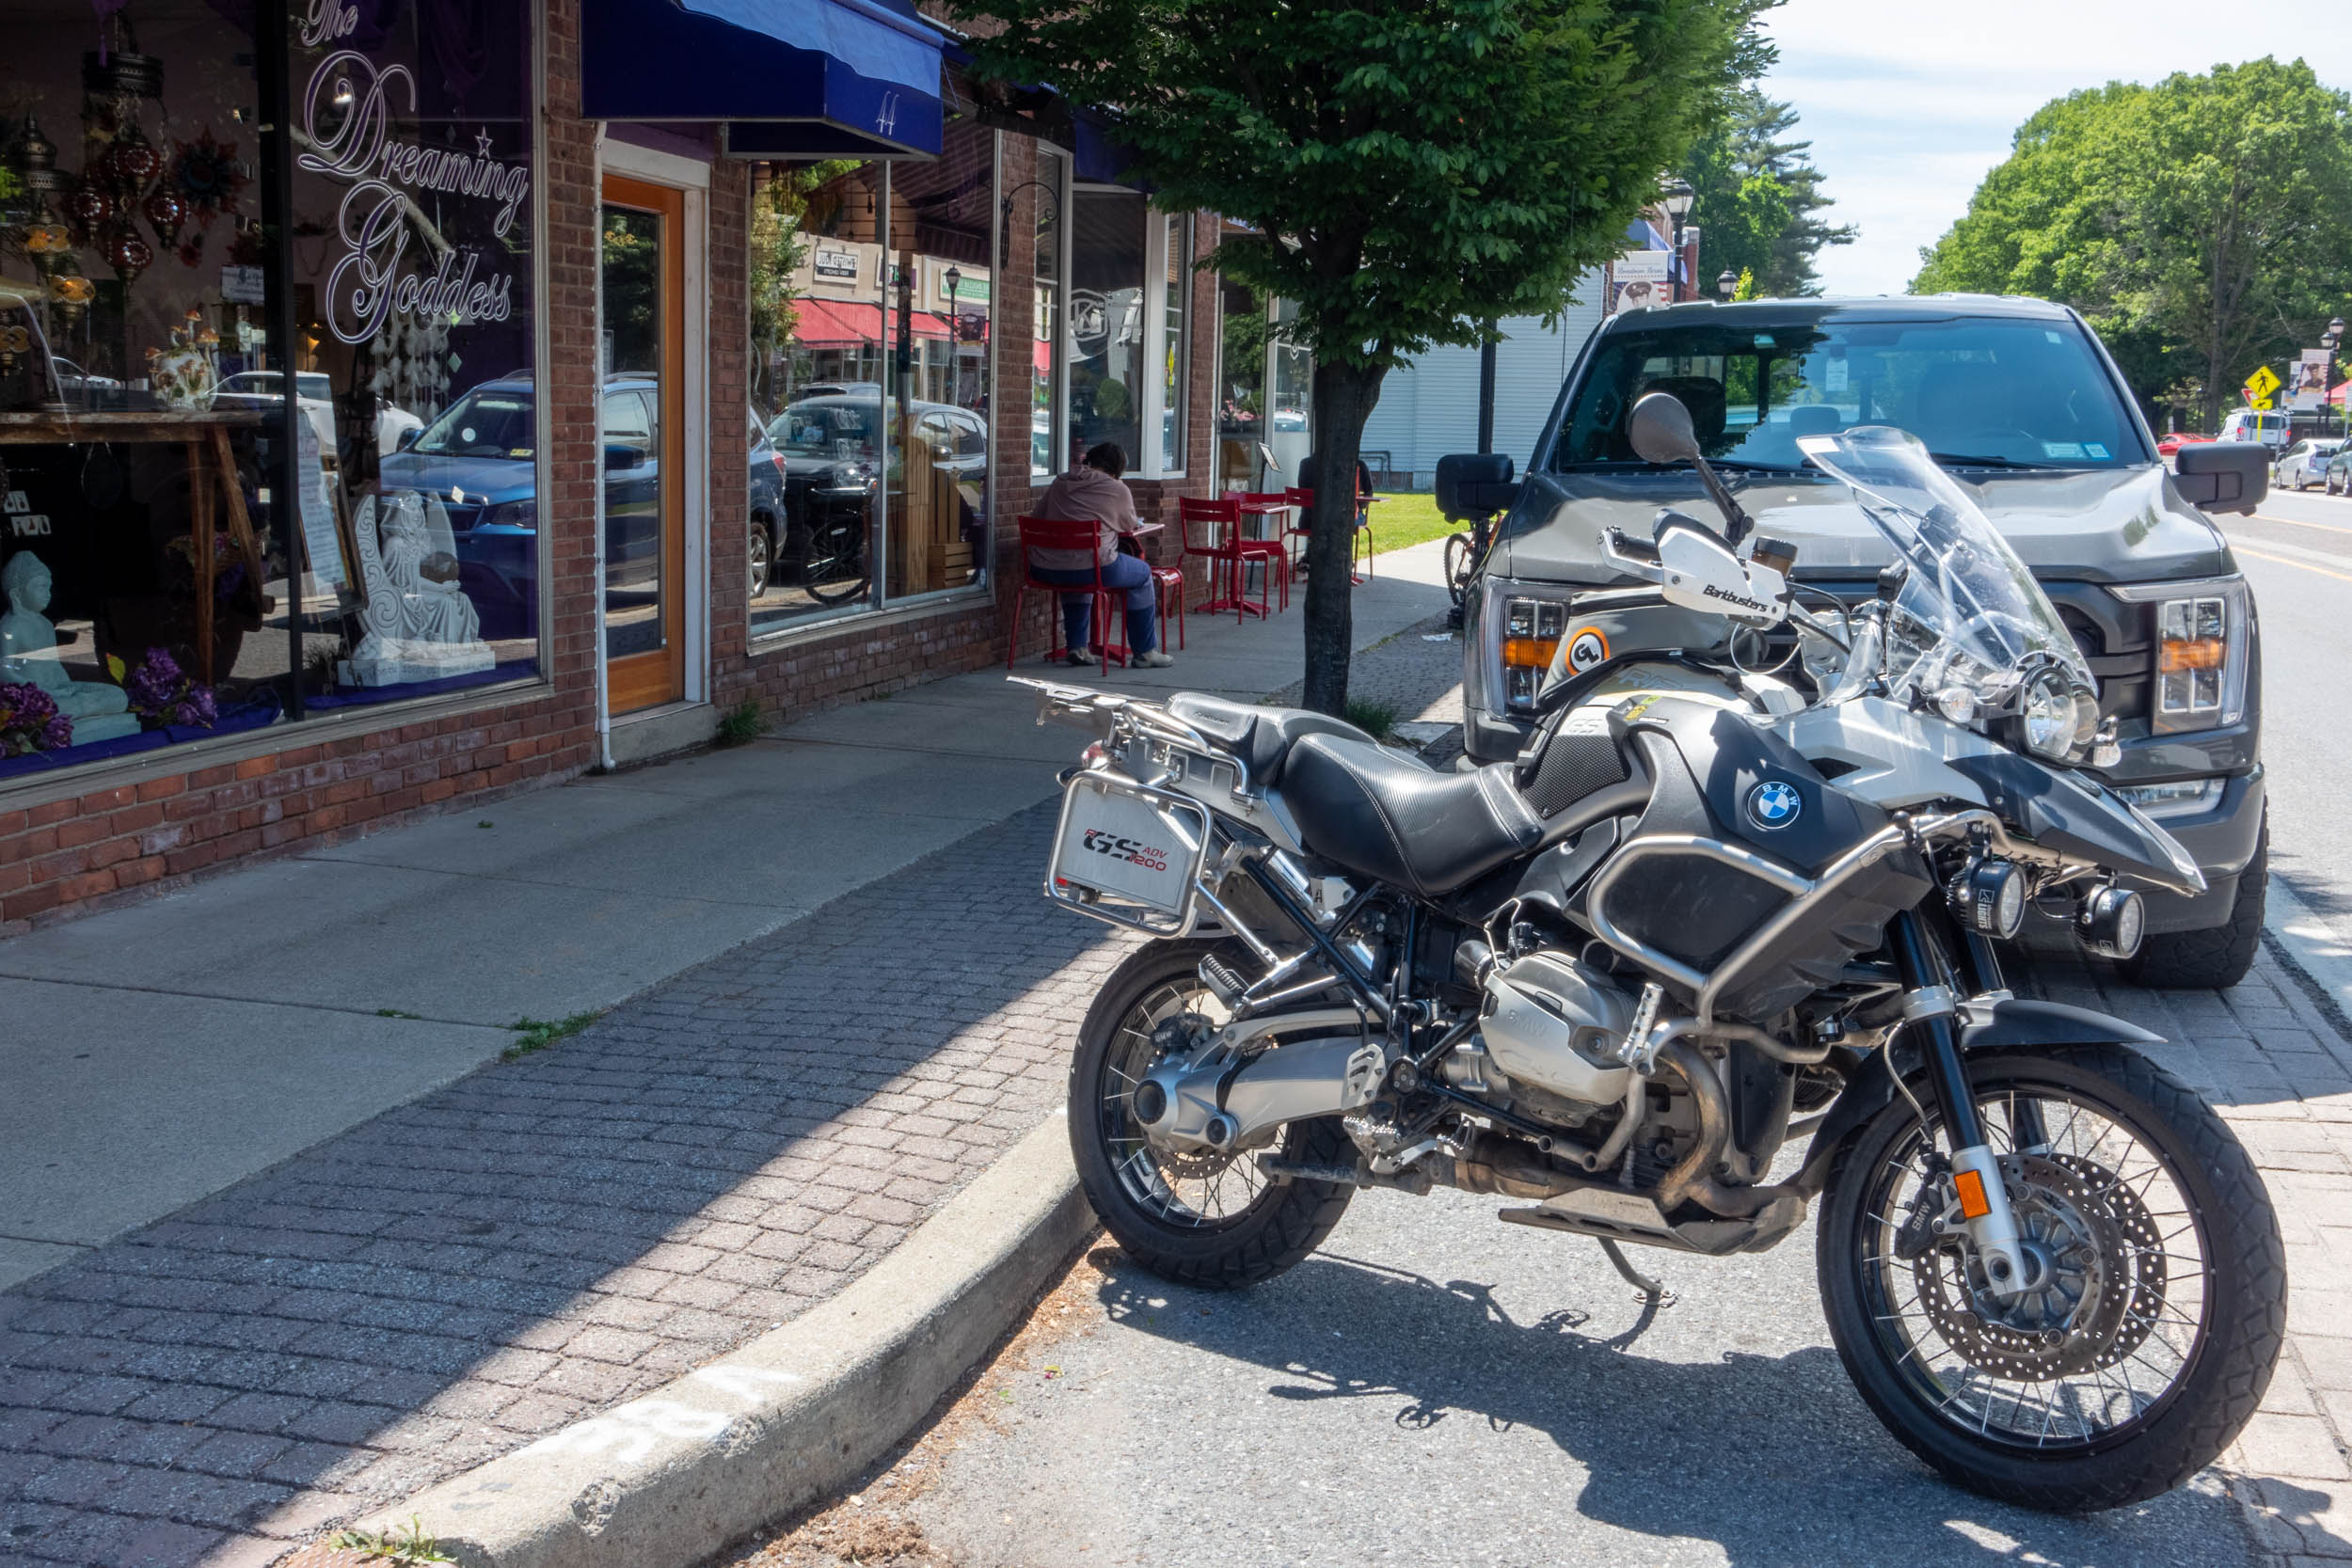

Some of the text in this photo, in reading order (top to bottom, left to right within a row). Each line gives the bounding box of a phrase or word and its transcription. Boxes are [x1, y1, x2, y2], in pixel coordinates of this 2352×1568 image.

[301, 0, 358, 46] The
[876, 90, 900, 136] 44
[298, 50, 530, 237] Dreaming
[326, 181, 512, 344] Goddess
[1703, 583, 1770, 612] Barkbusters
[1761, 784, 1799, 806] BMW
[1083, 831, 1169, 862] GS ADV
[1129, 852, 1168, 872] 1200
[1154, 1030, 1172, 1043] BMW
[1911, 1201, 1931, 1231] BMW
